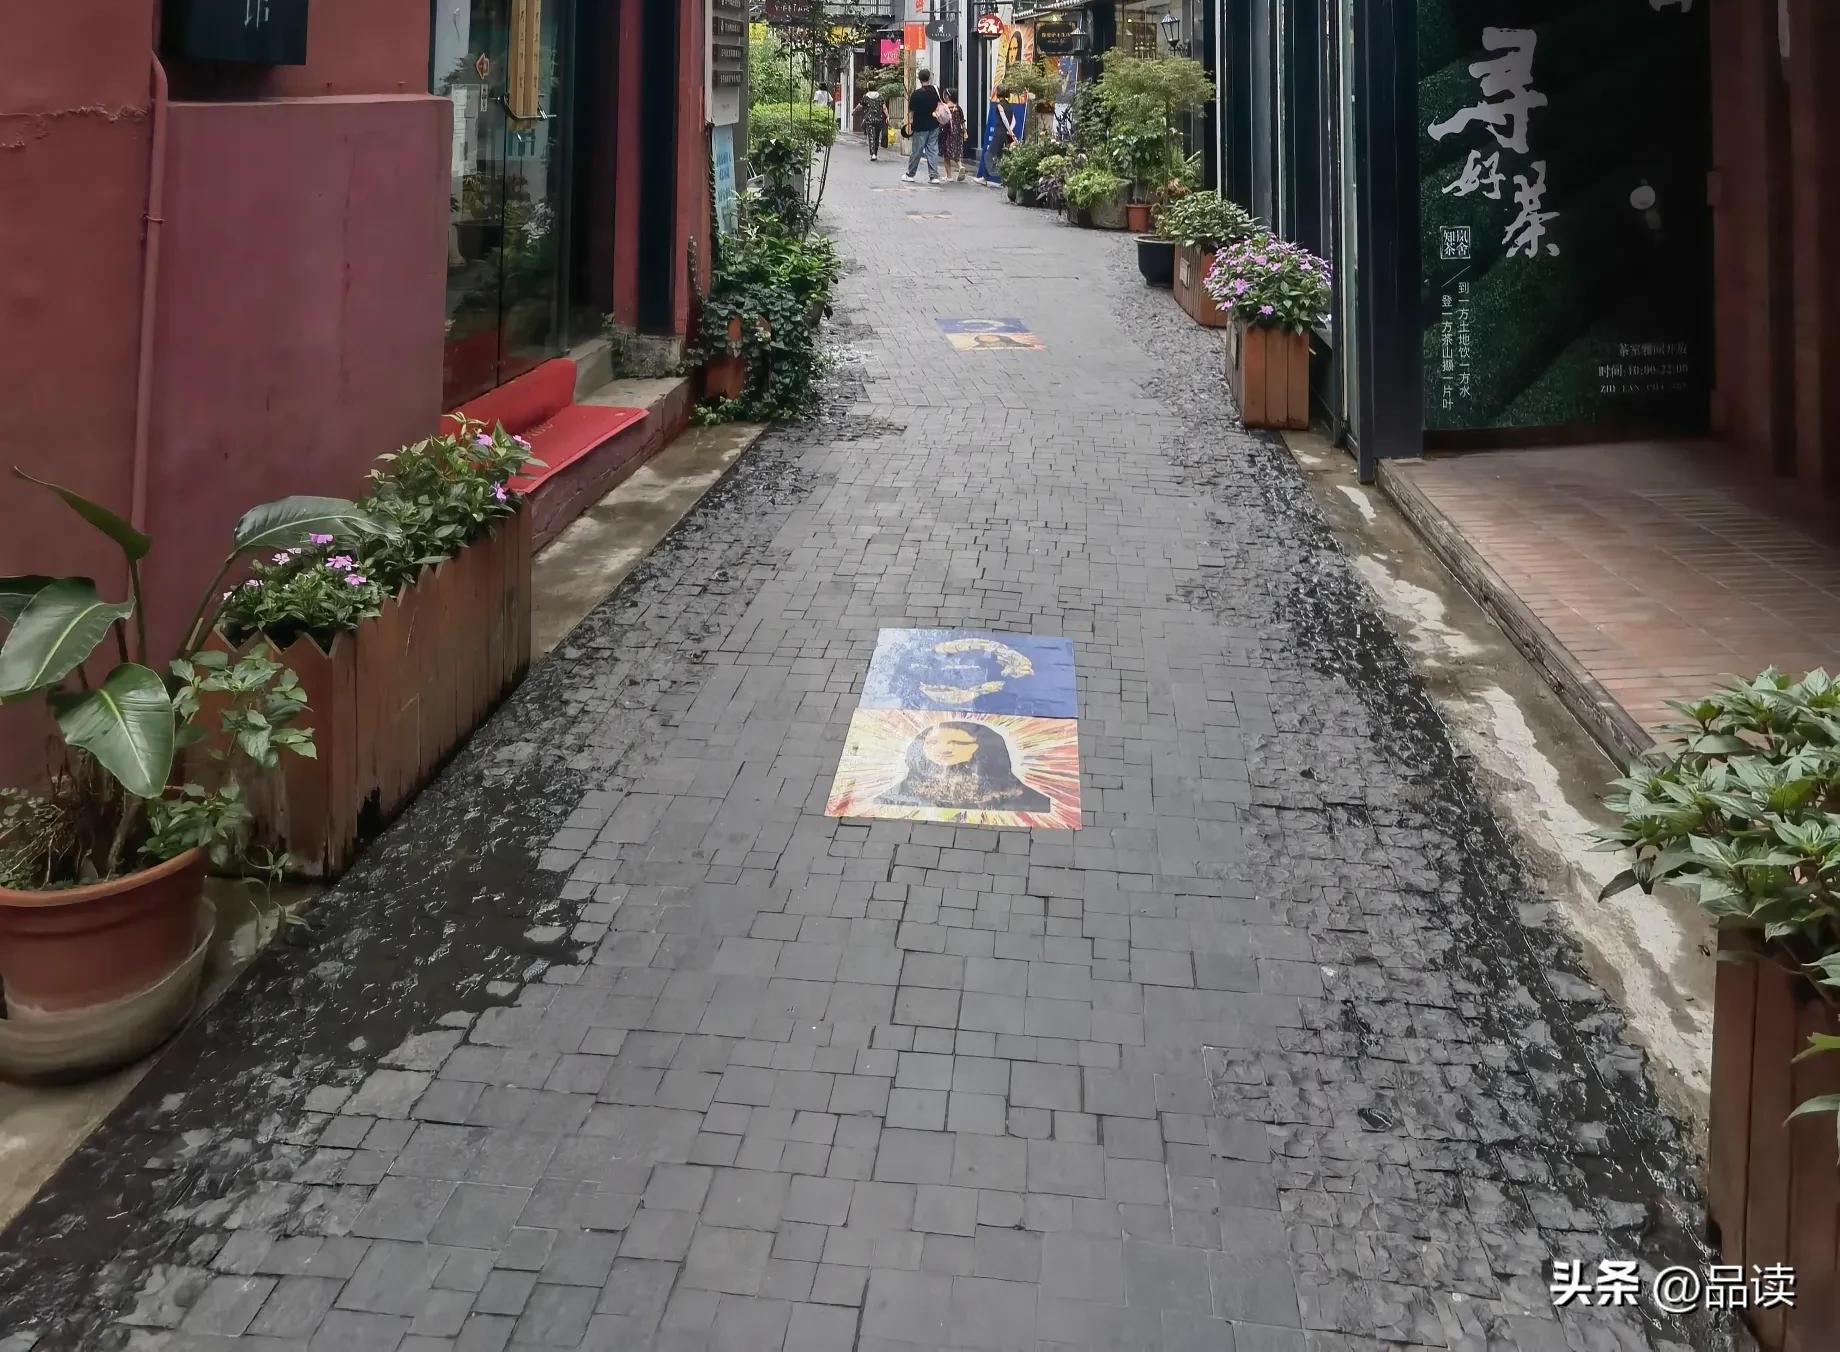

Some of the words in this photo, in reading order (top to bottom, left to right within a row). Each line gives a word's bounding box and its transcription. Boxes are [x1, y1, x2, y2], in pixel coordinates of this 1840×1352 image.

[1427, 26, 1561, 258] 寻好茶
[1458, 281, 1471, 398] 到一方土地饮一方水
